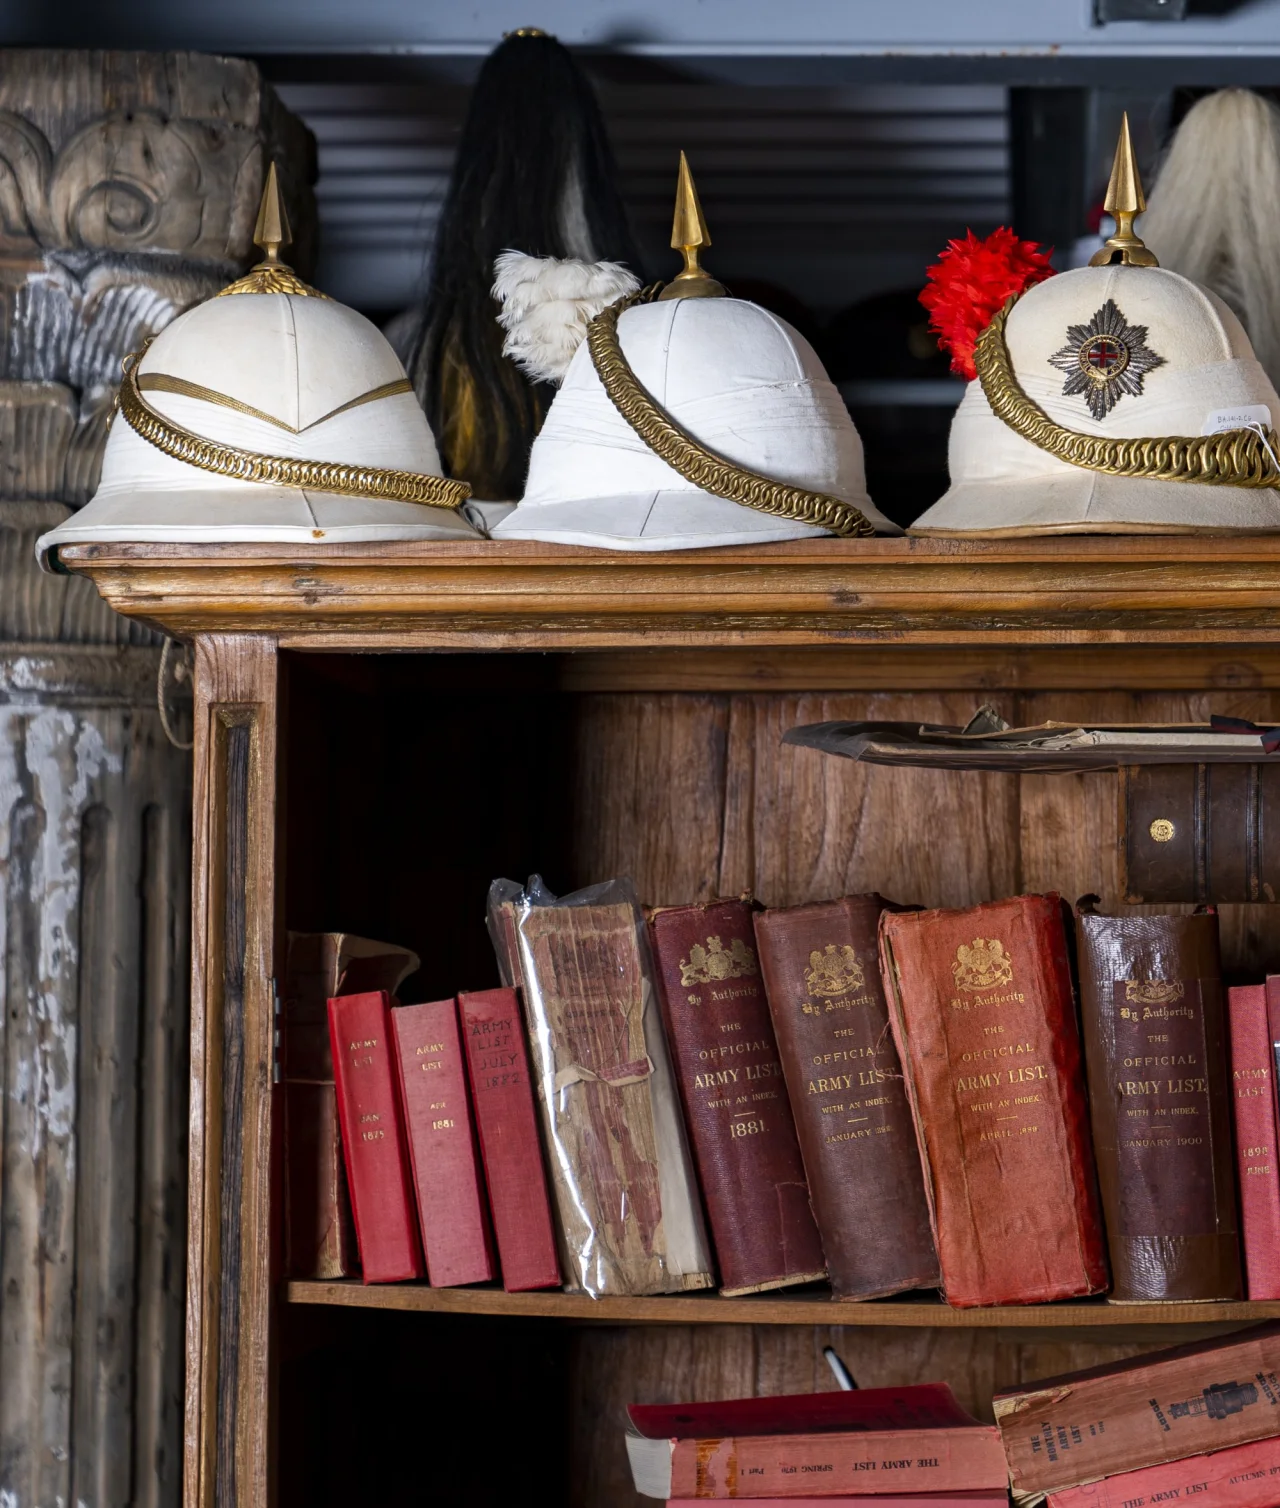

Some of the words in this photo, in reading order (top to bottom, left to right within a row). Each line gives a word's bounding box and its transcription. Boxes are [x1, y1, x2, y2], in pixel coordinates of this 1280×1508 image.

[951, 998, 970, 1011] By
[973, 991, 1025, 1009] Authority
[802, 1003, 821, 1017] By
[1120, 1008, 1139, 1022] By
[1142, 1006, 1194, 1021] Authority
[472, 1018, 513, 1036] ARMY
[720, 1023, 741, 1033] THE
[833, 1028, 855, 1038] THE
[983, 1025, 1005, 1036] THE
[350, 1039, 377, 1050] ARMY
[478, 1035, 509, 1050] LIST
[1147, 1035, 1169, 1043] THE
[416, 1043, 445, 1055] ARMY
[699, 1041, 769, 1060] OFFICIAL
[962, 1043, 1034, 1062] OFFICIAL
[481, 1053, 518, 1070] JULY
[813, 1047, 885, 1066] OFFICIAL
[1123, 1054, 1196, 1067] OFFICIAL
[421, 1060, 443, 1071] LIST
[486, 1073, 521, 1088] 1882
[694, 1068, 740, 1089] ARMY
[956, 1072, 1001, 1092] ARMY
[1008, 1065, 1048, 1084] LIST.
[1233, 1068, 1269, 1080] ARMY
[807, 1074, 853, 1095] ARMY
[1118, 1080, 1161, 1095] ARMY
[1167, 1078, 1207, 1094] LIST.
[1238, 1086, 1266, 1098] LIST
[707, 1099, 730, 1109] WITH
[736, 1096, 748, 1105] AN
[821, 1103, 844, 1115] WITH
[849, 1101, 860, 1110] AN
[865, 1096, 893, 1107] INDEX.
[970, 1102, 993, 1113] WITH
[998, 1100, 1010, 1109] AN
[1126, 1108, 1149, 1117] WITH
[1154, 1107, 1167, 1116] AN
[1170, 1106, 1199, 1115] INDEX.
[432, 1120, 454, 1130] 1881
[729, 1120, 770, 1138] 1881.
[362, 1131, 385, 1142] 1875
[825, 1128, 871, 1144] JANUARY
[1124, 1138, 1171, 1147] JANUARY
[1246, 1166, 1270, 1175] JUNE
[1147, 1398, 1171, 1432] LODGE
[1041, 1421, 1058, 1462] MONTHLY
[1056, 1425, 1070, 1450] ARMY
[1070, 1425, 1082, 1444] LIST
[1031, 1436, 1042, 1453] THE
[801, 1464, 833, 1473] SPRING
[852, 1462, 876, 1471] LIST
[881, 1460, 912, 1470] ARMY
[917, 1458, 940, 1468] THE
[748, 1467, 764, 1476] Part
[1122, 1491, 1147, 1508] THE
[1150, 1488, 1181, 1503] ARMY
[1185, 1481, 1209, 1496] LIST
[1229, 1469, 1266, 1485] AUTUMN
